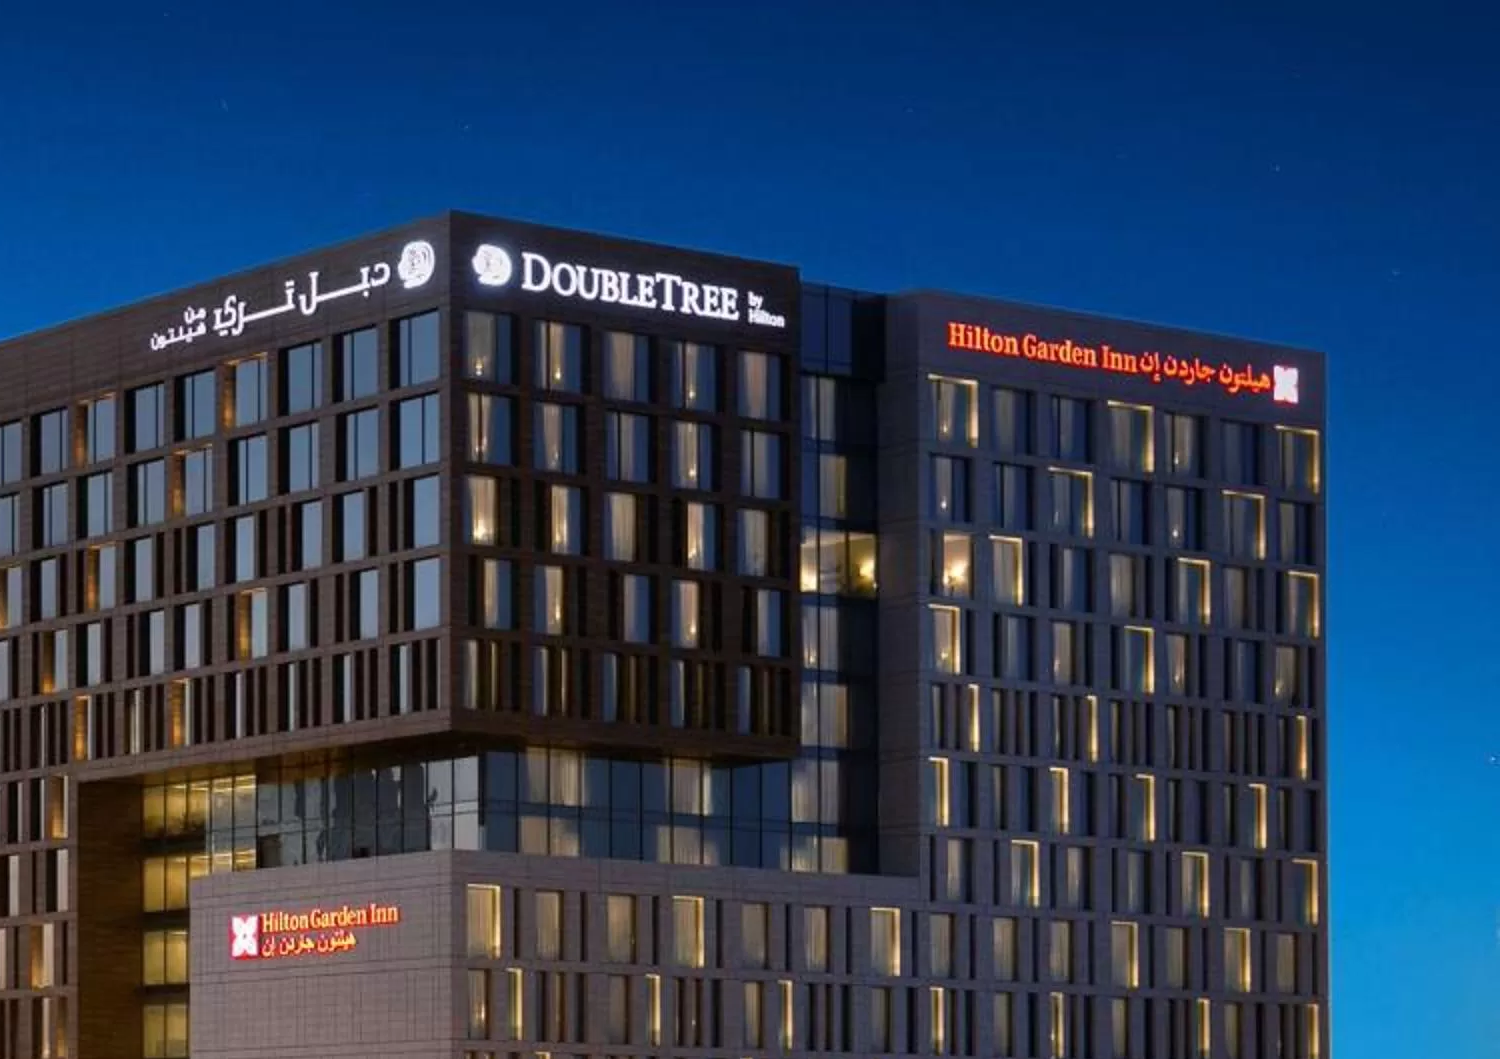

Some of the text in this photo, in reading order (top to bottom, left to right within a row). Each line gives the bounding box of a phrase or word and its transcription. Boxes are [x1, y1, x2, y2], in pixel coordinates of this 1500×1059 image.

[747, 290, 764, 309] by
[183, 306, 207, 325] من
[948, 321, 1138, 373] Hilton Garden Inn
[1139, 351, 1272, 393] هيلتون جاردن إن
[261, 903, 398, 933] Hilton Garden Inn
